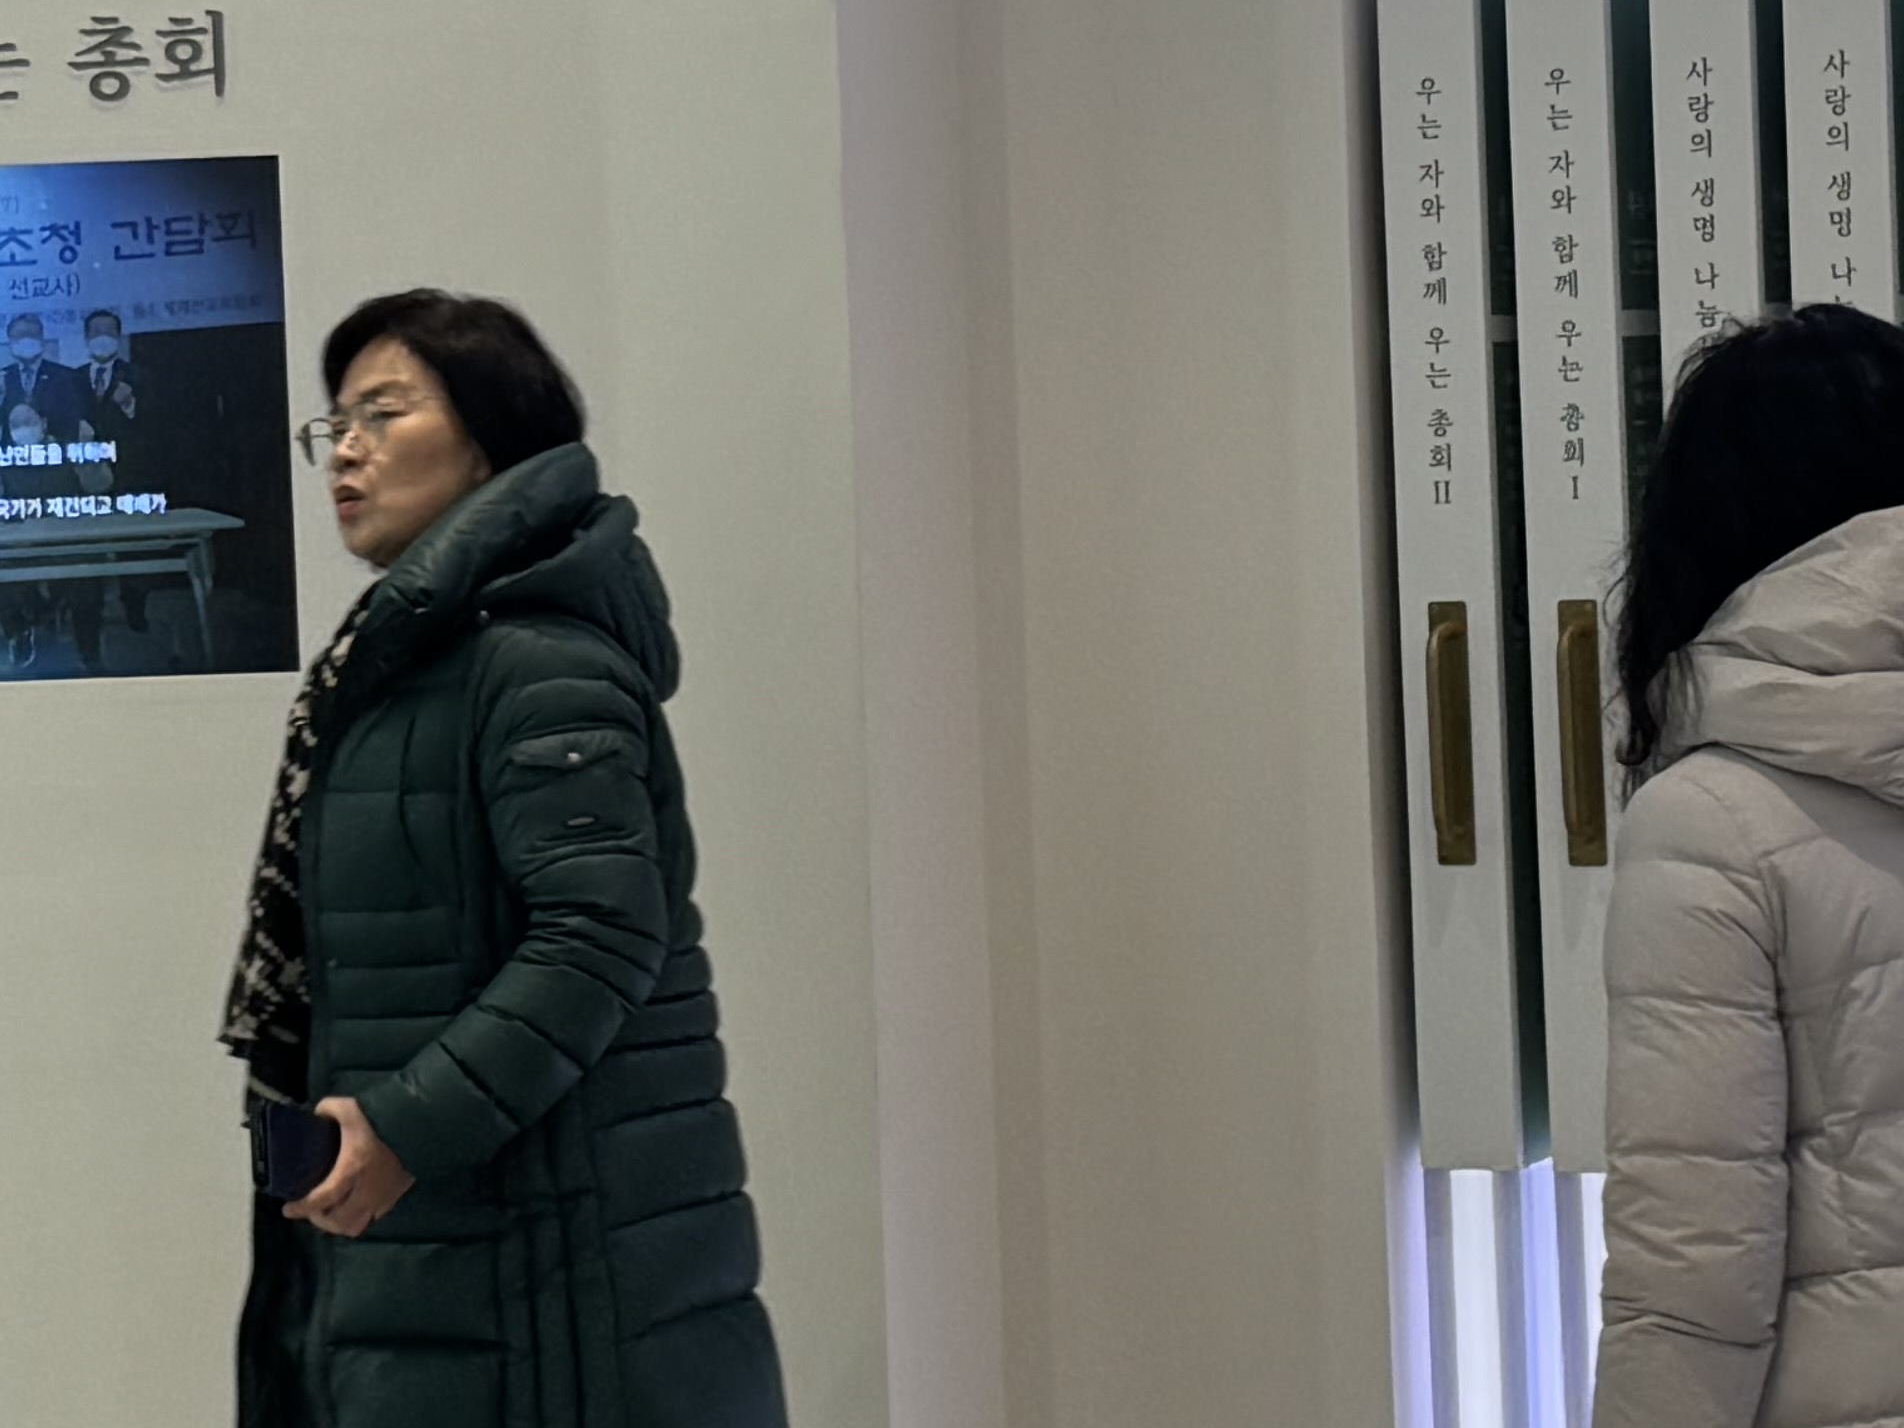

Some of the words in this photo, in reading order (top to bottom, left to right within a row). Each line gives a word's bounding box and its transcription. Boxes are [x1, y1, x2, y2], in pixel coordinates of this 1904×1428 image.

[67, 9, 225, 102] 총회
[1416, 76, 1442, 140] 우는
[1544, 67, 1572, 130] 우는
[1686, 56, 1714, 159] 사랑의
[1823, 49, 1851, 153] 사랑의
[1418, 159, 1445, 223] 자와
[1548, 149, 1576, 213] 자와
[1690, 178, 1717, 243] 생명
[1827, 170, 1854, 238] 생명
[110, 209, 258, 262] 간담회
[1552, 234, 1579, 299] 함께
[1422, 242, 1448, 305] 함께
[1831, 256, 1857, 304] 나
[1425, 326, 1451, 389] 우는
[1556, 319, 1583, 383] 우는
